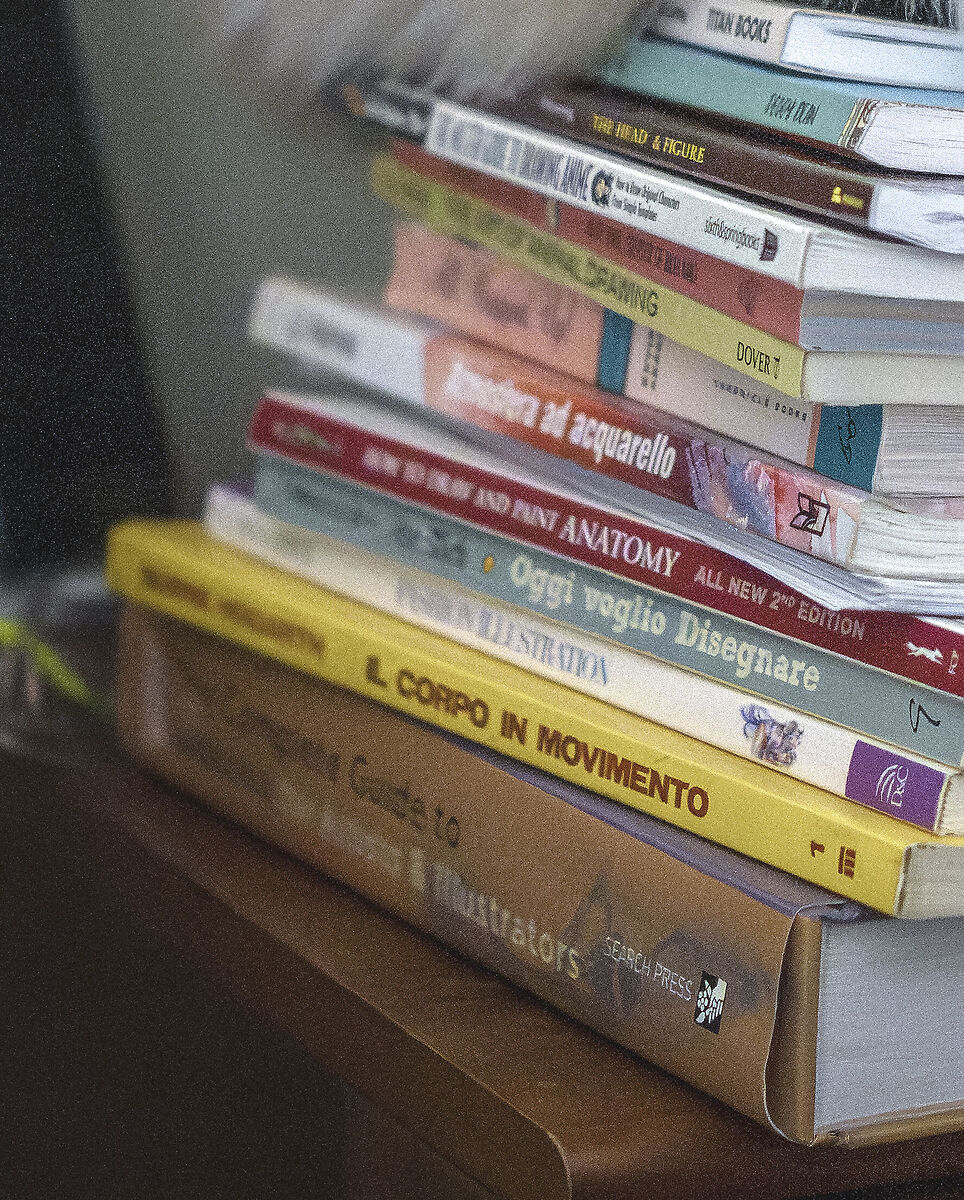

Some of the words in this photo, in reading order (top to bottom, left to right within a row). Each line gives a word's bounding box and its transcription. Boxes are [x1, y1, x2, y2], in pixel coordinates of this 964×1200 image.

[733, 14, 772, 44] BOOKS
[615, 121, 649, 145] HEAD
[652, 134, 662, 152] &
[663, 136, 706, 164] FIGURE
[736, 341, 771, 376] DOVER
[569, 411, 677, 480] acquarello
[559, 514, 681, 577] ANATOMY
[694, 565, 724, 591] ALL
[727, 576, 768, 605] NEW
[797, 599, 865, 640] EDITION
[510, 555, 577, 609] Oggi
[583, 584, 667, 637] voglio
[674, 609, 821, 692] Disegnare
[396, 668, 490, 730] CORPO
[500, 710, 529, 746] IN
[537, 723, 711, 820] MOVIMENTO
[603, 935, 651, 975] SEARCH
[652, 961, 693, 1002] PRESS
